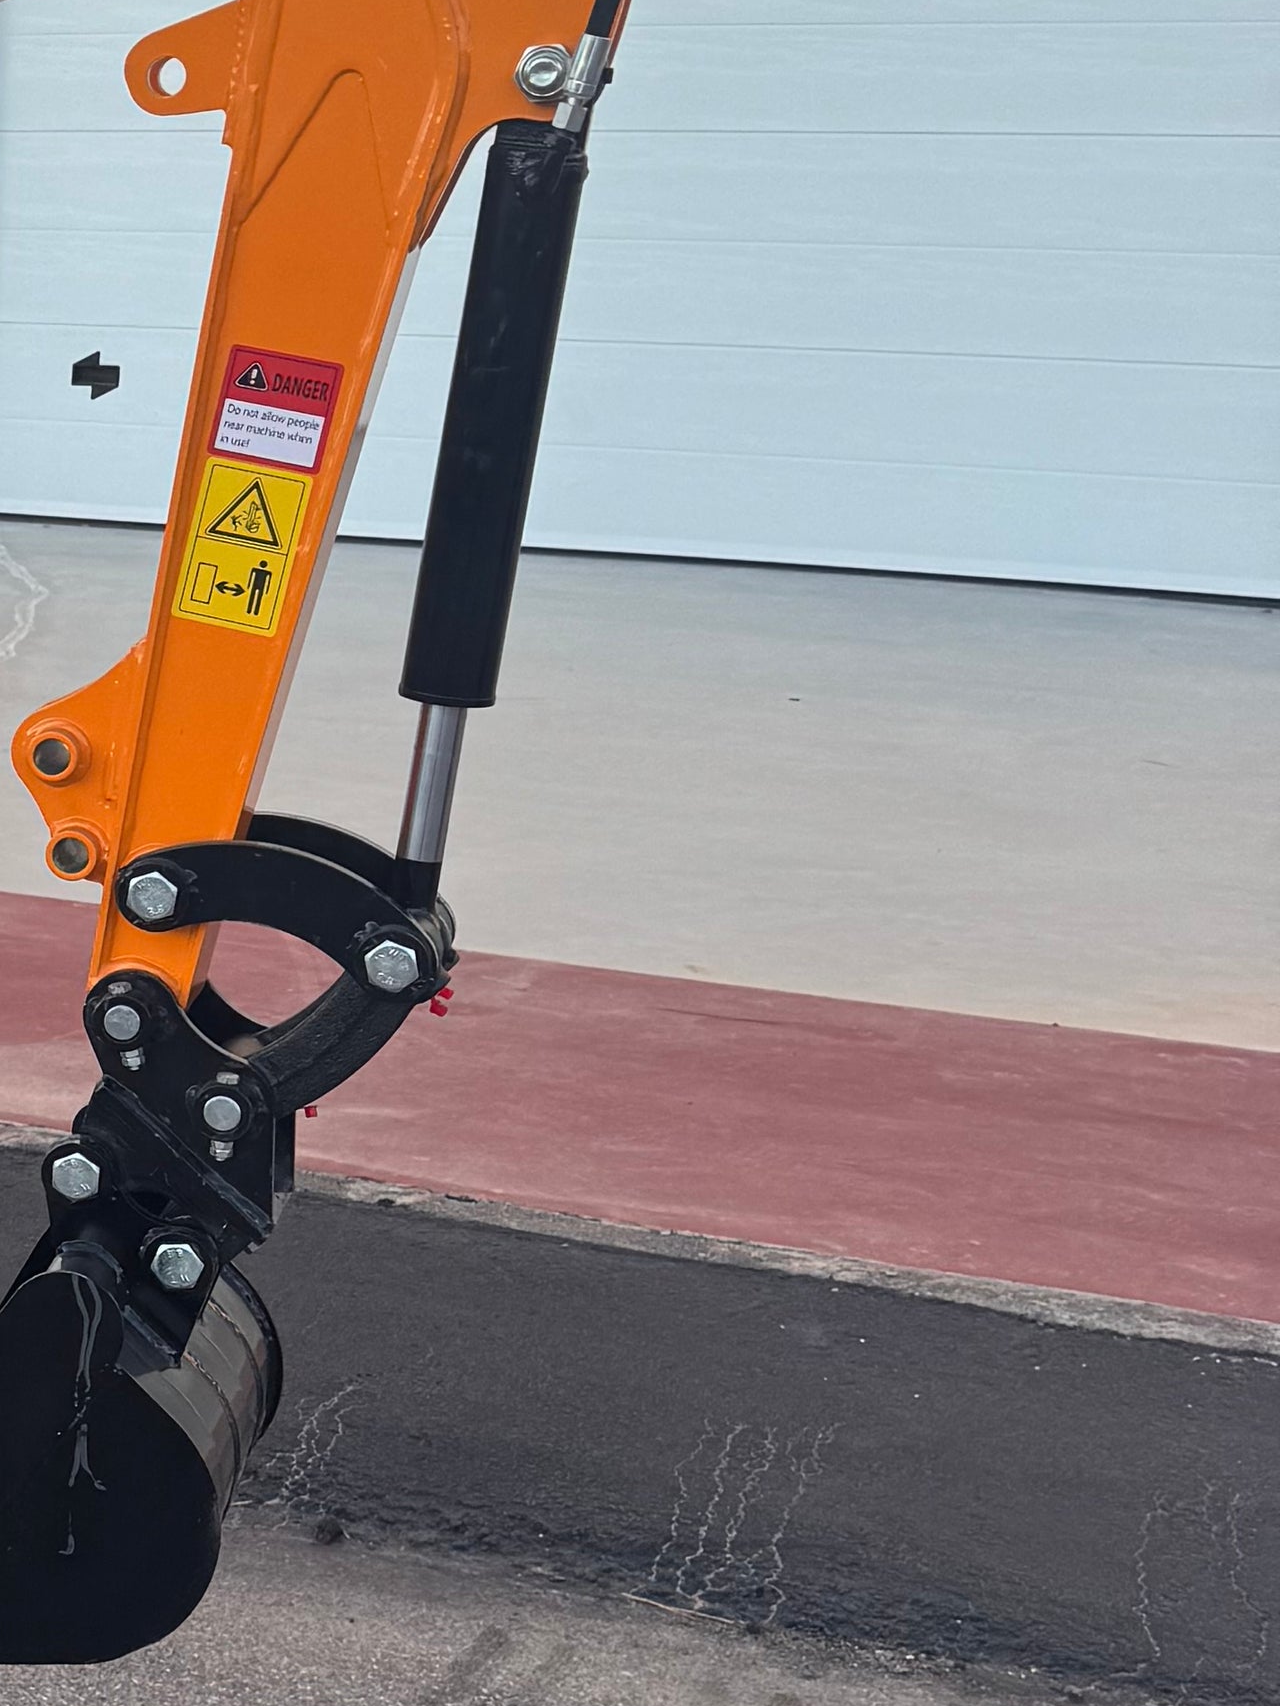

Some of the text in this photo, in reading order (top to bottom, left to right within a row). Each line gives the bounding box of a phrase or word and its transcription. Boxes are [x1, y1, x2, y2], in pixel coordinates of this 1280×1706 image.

[272, 373, 330, 402] DANGER
[227, 403, 320, 431] Do not allow people
[220, 435, 229, 443] in
[223, 420, 313, 445] near machine when
